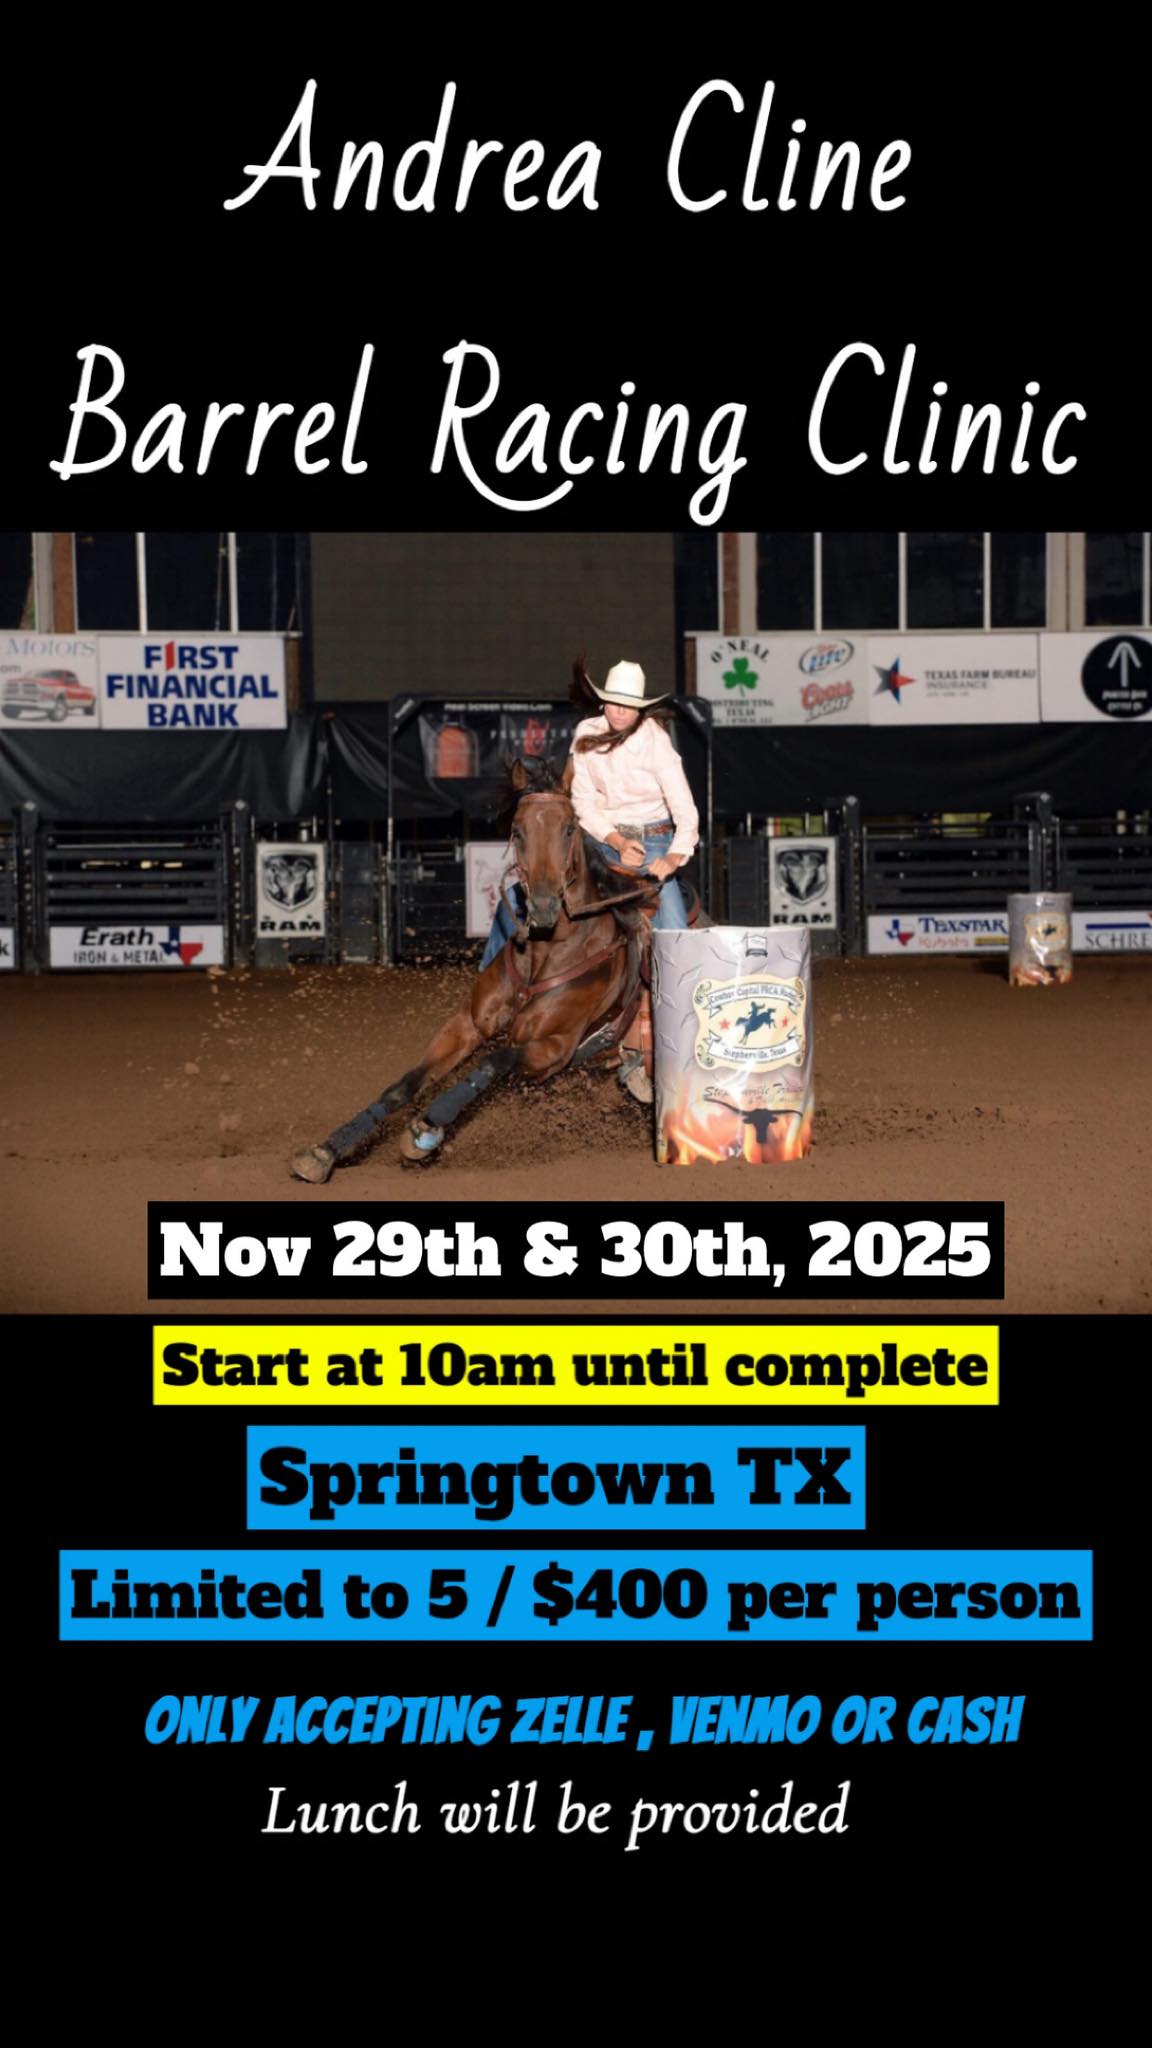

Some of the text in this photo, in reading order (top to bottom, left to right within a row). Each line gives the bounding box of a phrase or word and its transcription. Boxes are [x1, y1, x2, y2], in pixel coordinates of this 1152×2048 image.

[7, 637, 97, 656] Motors
[144, 641, 239, 671] FIRST
[925, 669, 1037, 680] TEXAS FARM BUREAU
[106, 674, 278, 699] FINANCIAL
[926, 681, 987, 690] INSURANCE
[148, 704, 239, 727] BANK
[260, 920, 322, 931] RAM
[773, 914, 832, 925] RAM
[80, 926, 154, 946] Erath
[74, 950, 106, 963] IRON
[111, 953, 119, 963] &
